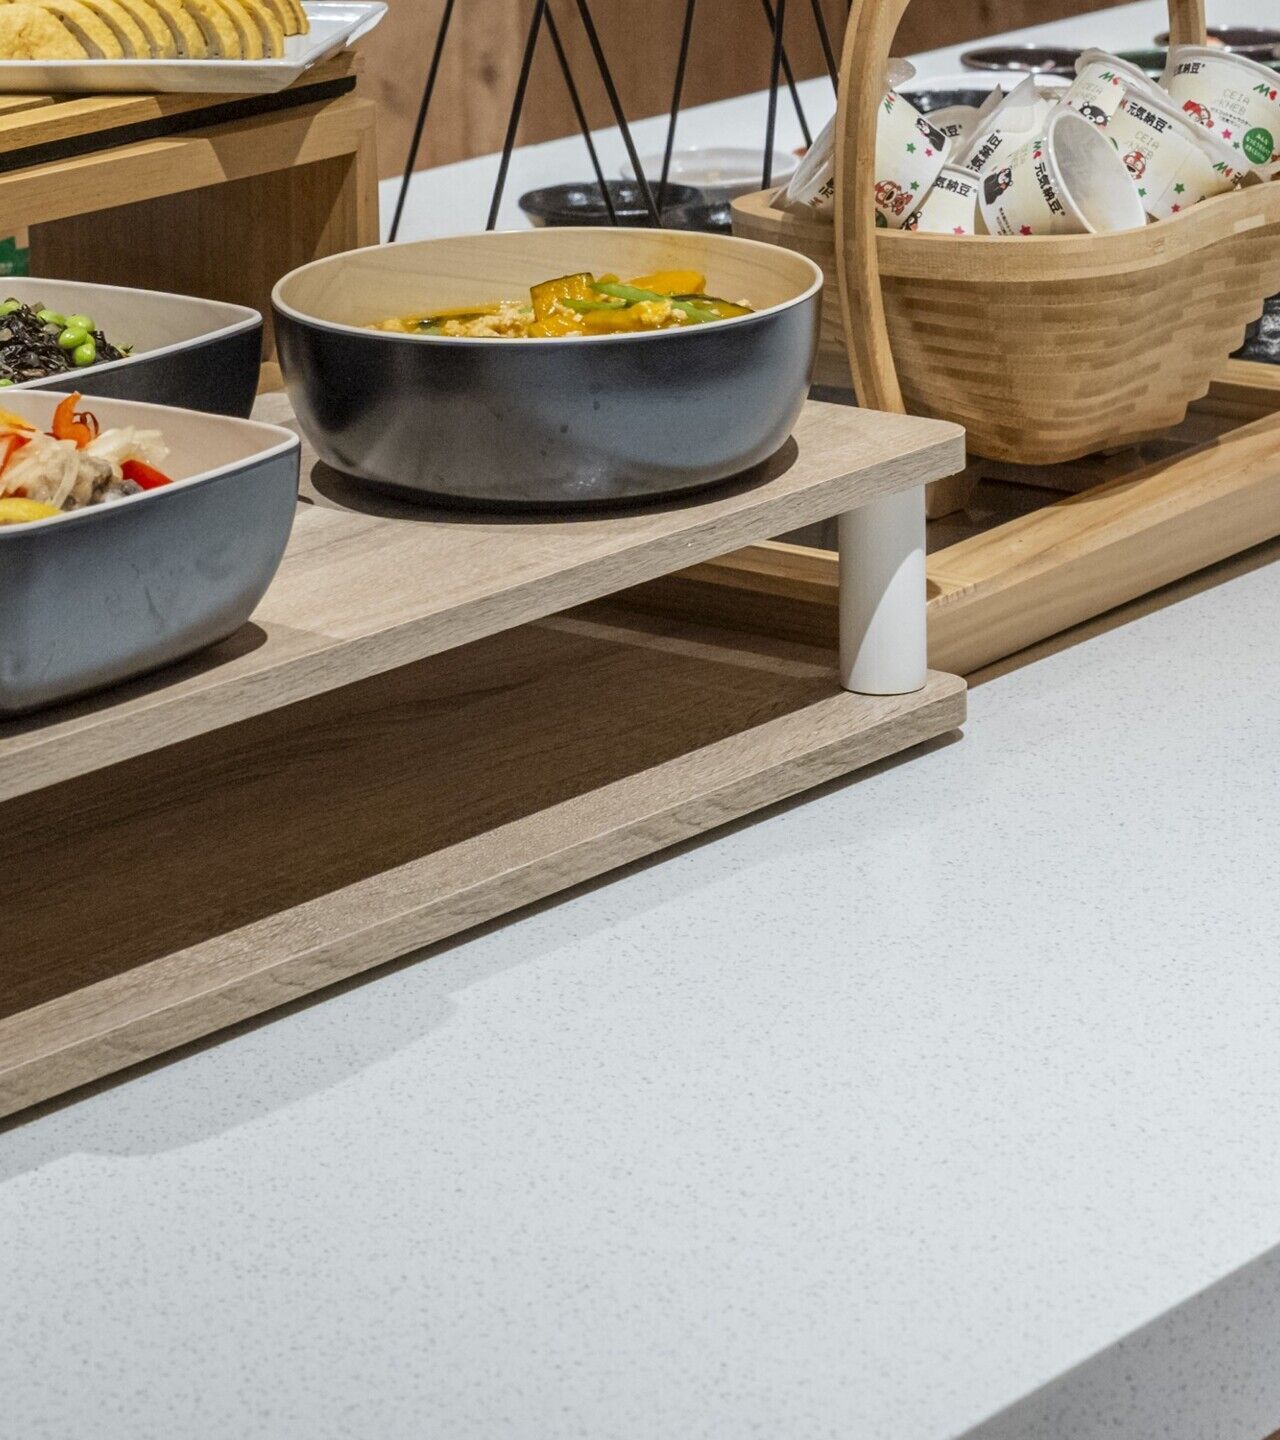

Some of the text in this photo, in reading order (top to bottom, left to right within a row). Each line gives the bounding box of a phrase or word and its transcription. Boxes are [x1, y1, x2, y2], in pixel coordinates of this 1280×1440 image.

[1127, 101, 1169, 134] 元気納豆
[1035, 162, 1063, 214] 元気納豆
